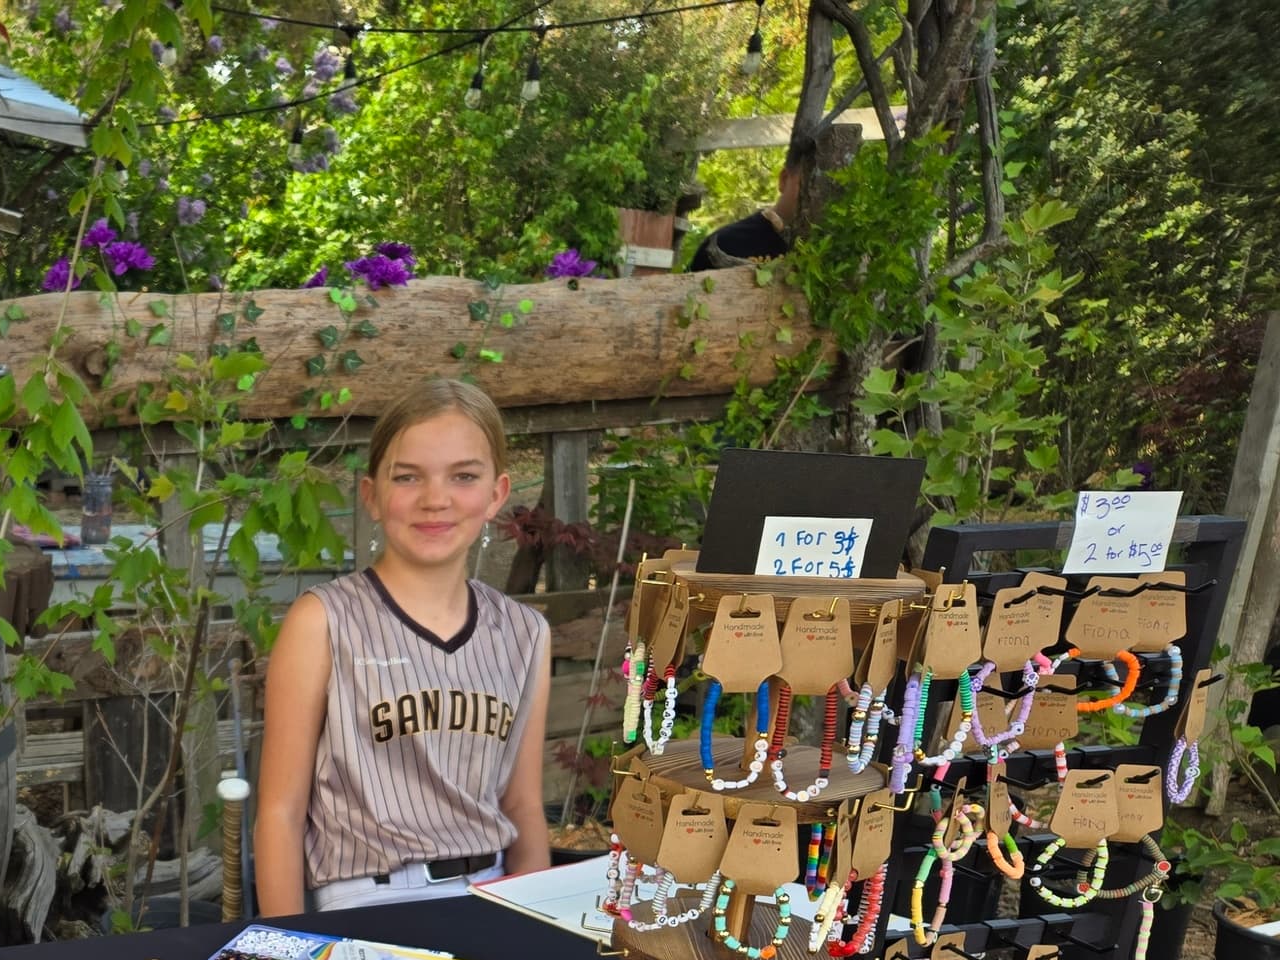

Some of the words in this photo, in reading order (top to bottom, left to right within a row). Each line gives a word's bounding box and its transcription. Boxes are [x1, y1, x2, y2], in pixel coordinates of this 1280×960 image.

[1107, 524, 1125, 536] or
[775, 532, 786, 547] 1
[1083, 543, 1097, 564] 2
[1106, 546, 1124, 560] for
[774, 558, 786, 576] 2
[723, 623, 765, 631] Handmade
[795, 624, 839, 634] Handmade
[372, 689, 440, 742] SAN
[448, 690, 514, 742] DIEG
[675, 819, 715, 828] Handmade
[743, 830, 784, 839] Handmade
